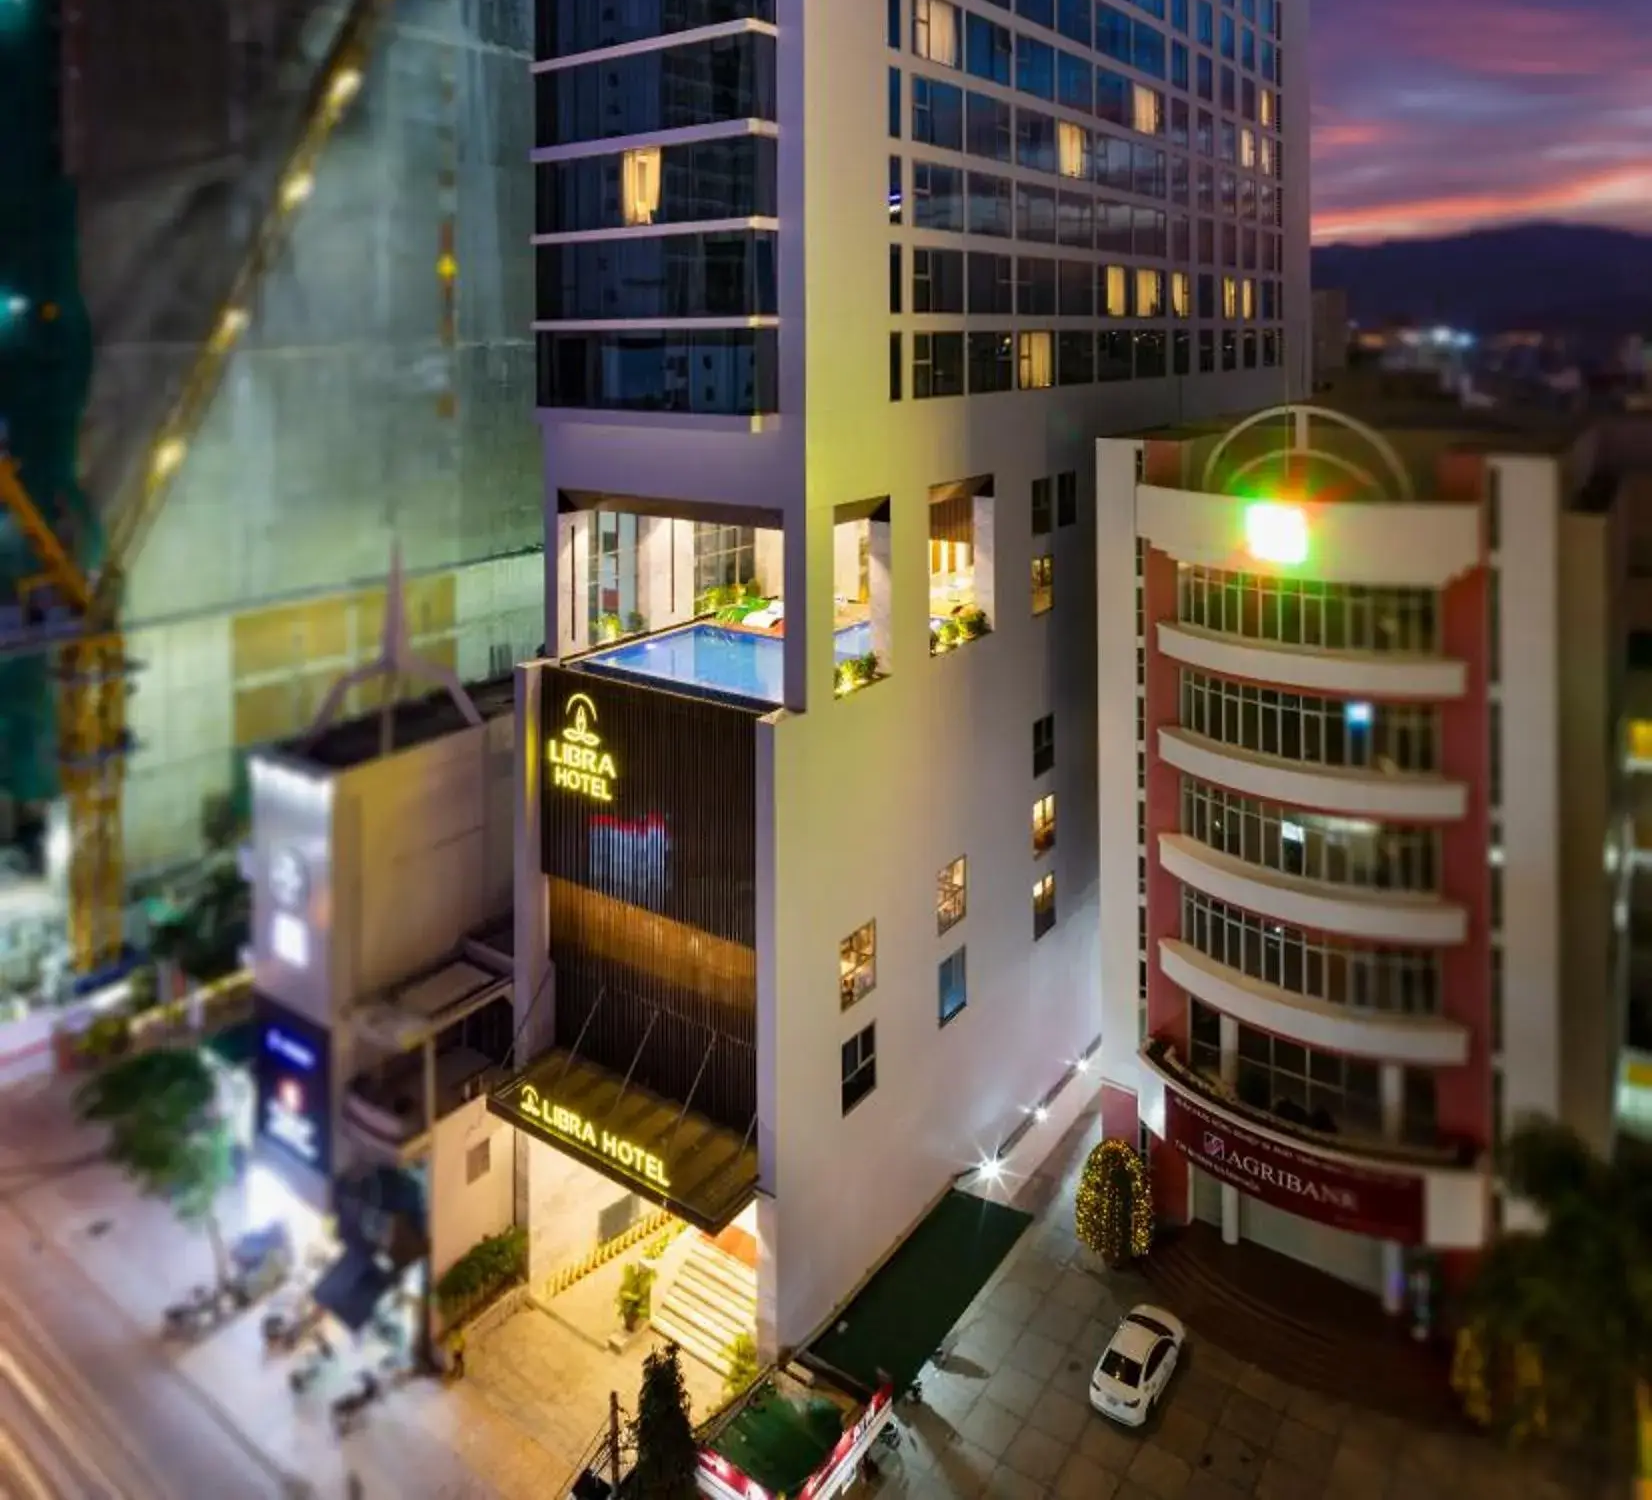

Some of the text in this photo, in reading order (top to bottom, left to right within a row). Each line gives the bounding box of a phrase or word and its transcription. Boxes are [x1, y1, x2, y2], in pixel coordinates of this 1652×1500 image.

[549, 739, 616, 779] LIBRA
[555, 766, 612, 800] HOTEL
[543, 1098, 671, 1188] LIBRA HOTEL
